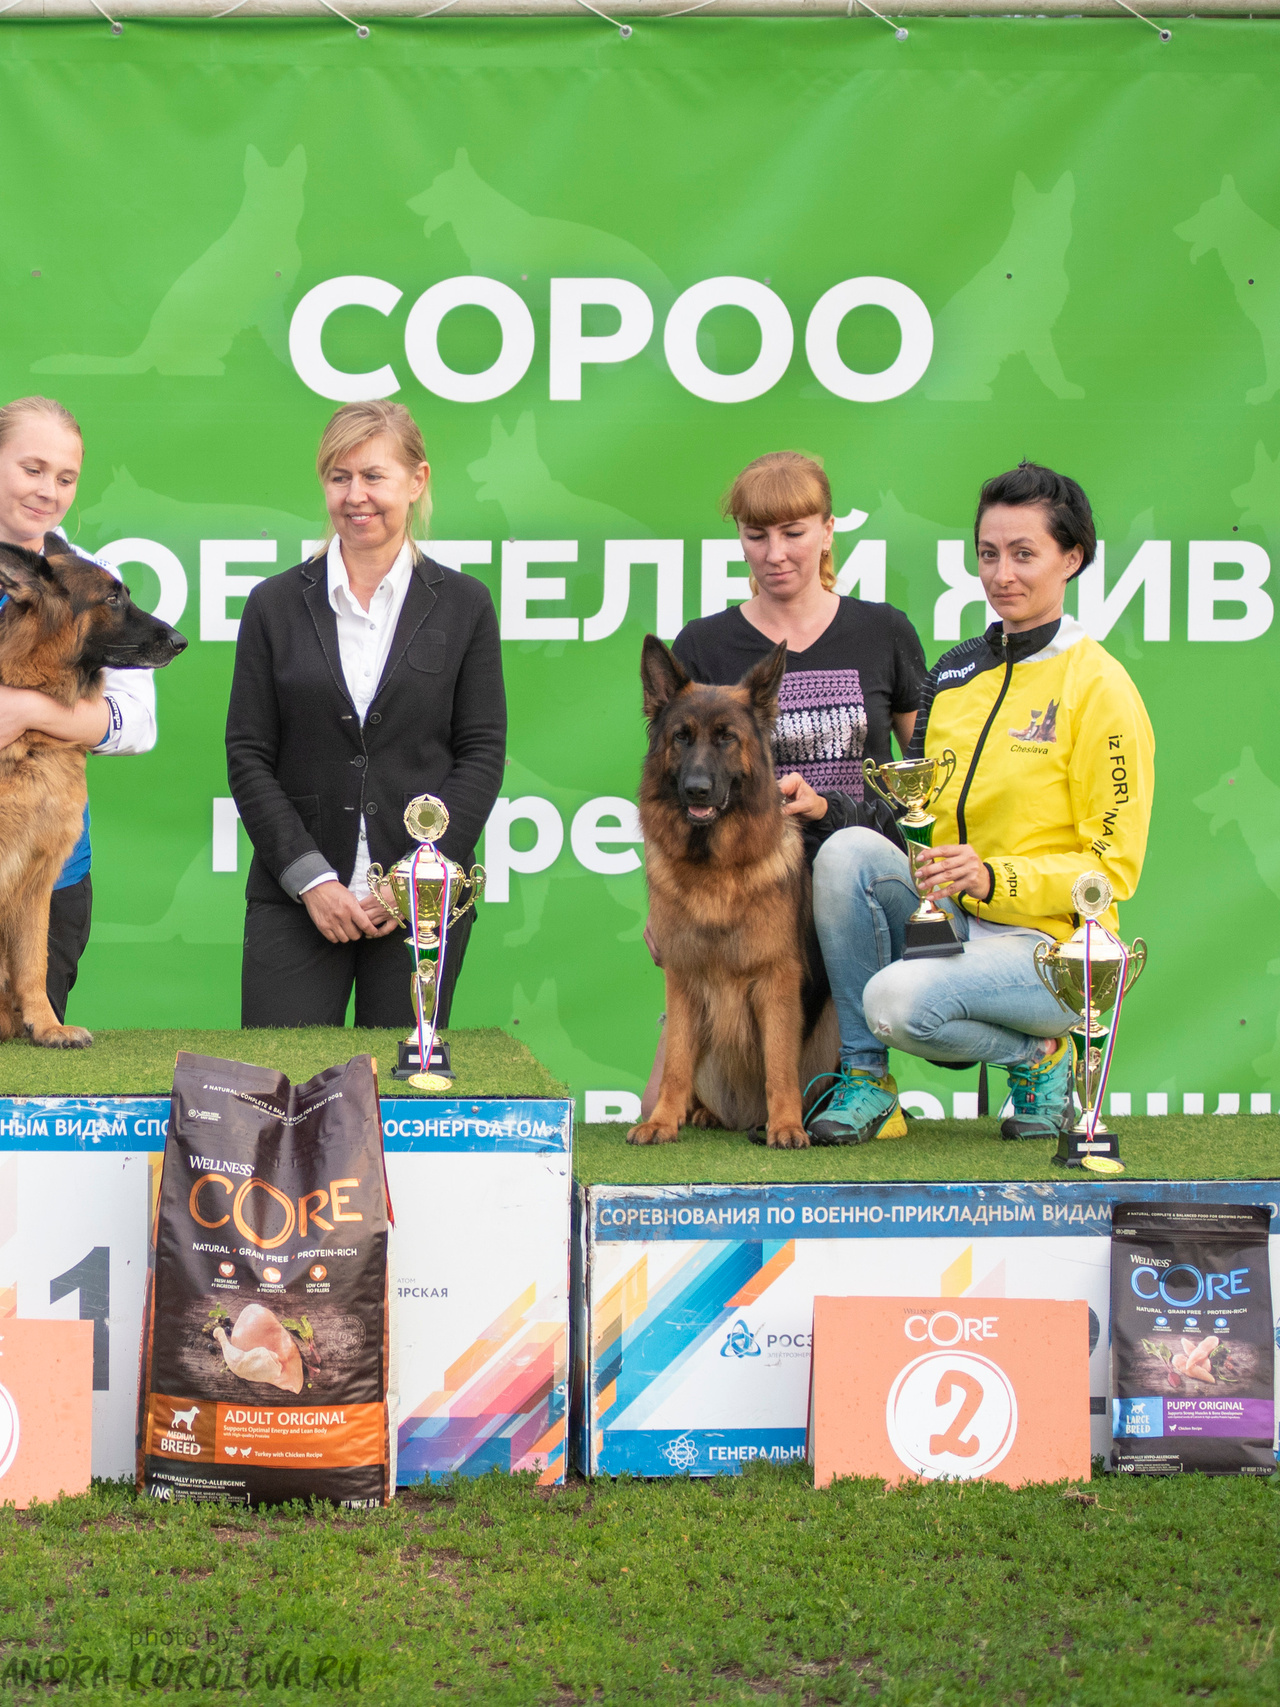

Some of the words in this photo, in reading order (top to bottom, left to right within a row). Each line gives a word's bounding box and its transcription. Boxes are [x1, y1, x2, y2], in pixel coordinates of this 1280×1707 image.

[289, 275, 934, 403] СОРОО
[240, 1092, 268, 1109] COMPLETE
[313, 1098, 328, 1110] ADULT
[55, 1119, 128, 1139] ВИДАМ
[189, 1155, 252, 1176] WELLNESS
[189, 1173, 364, 1249] CORE
[600, 1207, 760, 1226] СОРЕВНОВАНИЯ
[767, 1206, 795, 1224] ПО
[802, 1205, 1036, 1226] ВОЕННО-ПРИКЛАДНЫМ
[1042, 1203, 1111, 1225] ВИДАМ
[192, 1242, 230, 1255] NATURAL
[238, 1247, 264, 1261] GRAIN
[266, 1255, 289, 1264] FREE
[297, 1247, 357, 1260] PROTEIN-RICH
[1130, 1254, 1170, 1267] WELLNESS
[1130, 1263, 1251, 1307] CORE
[1136, 1306, 1162, 1314] NATURAL
[1207, 1307, 1247, 1316] PROTEIN-RICH
[905, 1311, 999, 1346] CORE
[338, 1331, 358, 1346] 1926
[929, 1370, 984, 1457] 2
[1167, 1401, 1197, 1410] PUPPY
[1199, 1401, 1244, 1411] ORIGINAL
[224, 1410, 274, 1425] ADULT
[277, 1410, 347, 1426] ORIGINAL
[1126, 1415, 1150, 1424] LARGE
[166, 1431, 196, 1442] MEDIUM
[223, 1424, 248, 1433] Supports
[271, 1427, 289, 1435] Energy
[314, 1427, 328, 1435] Body
[1125, 1424, 1150, 1434] BREED
[160, 1438, 201, 1456] BREED
[157, 1473, 189, 1484] NATURALLY
[190, 1478, 246, 1487] HYPO-ALLERGENIC
